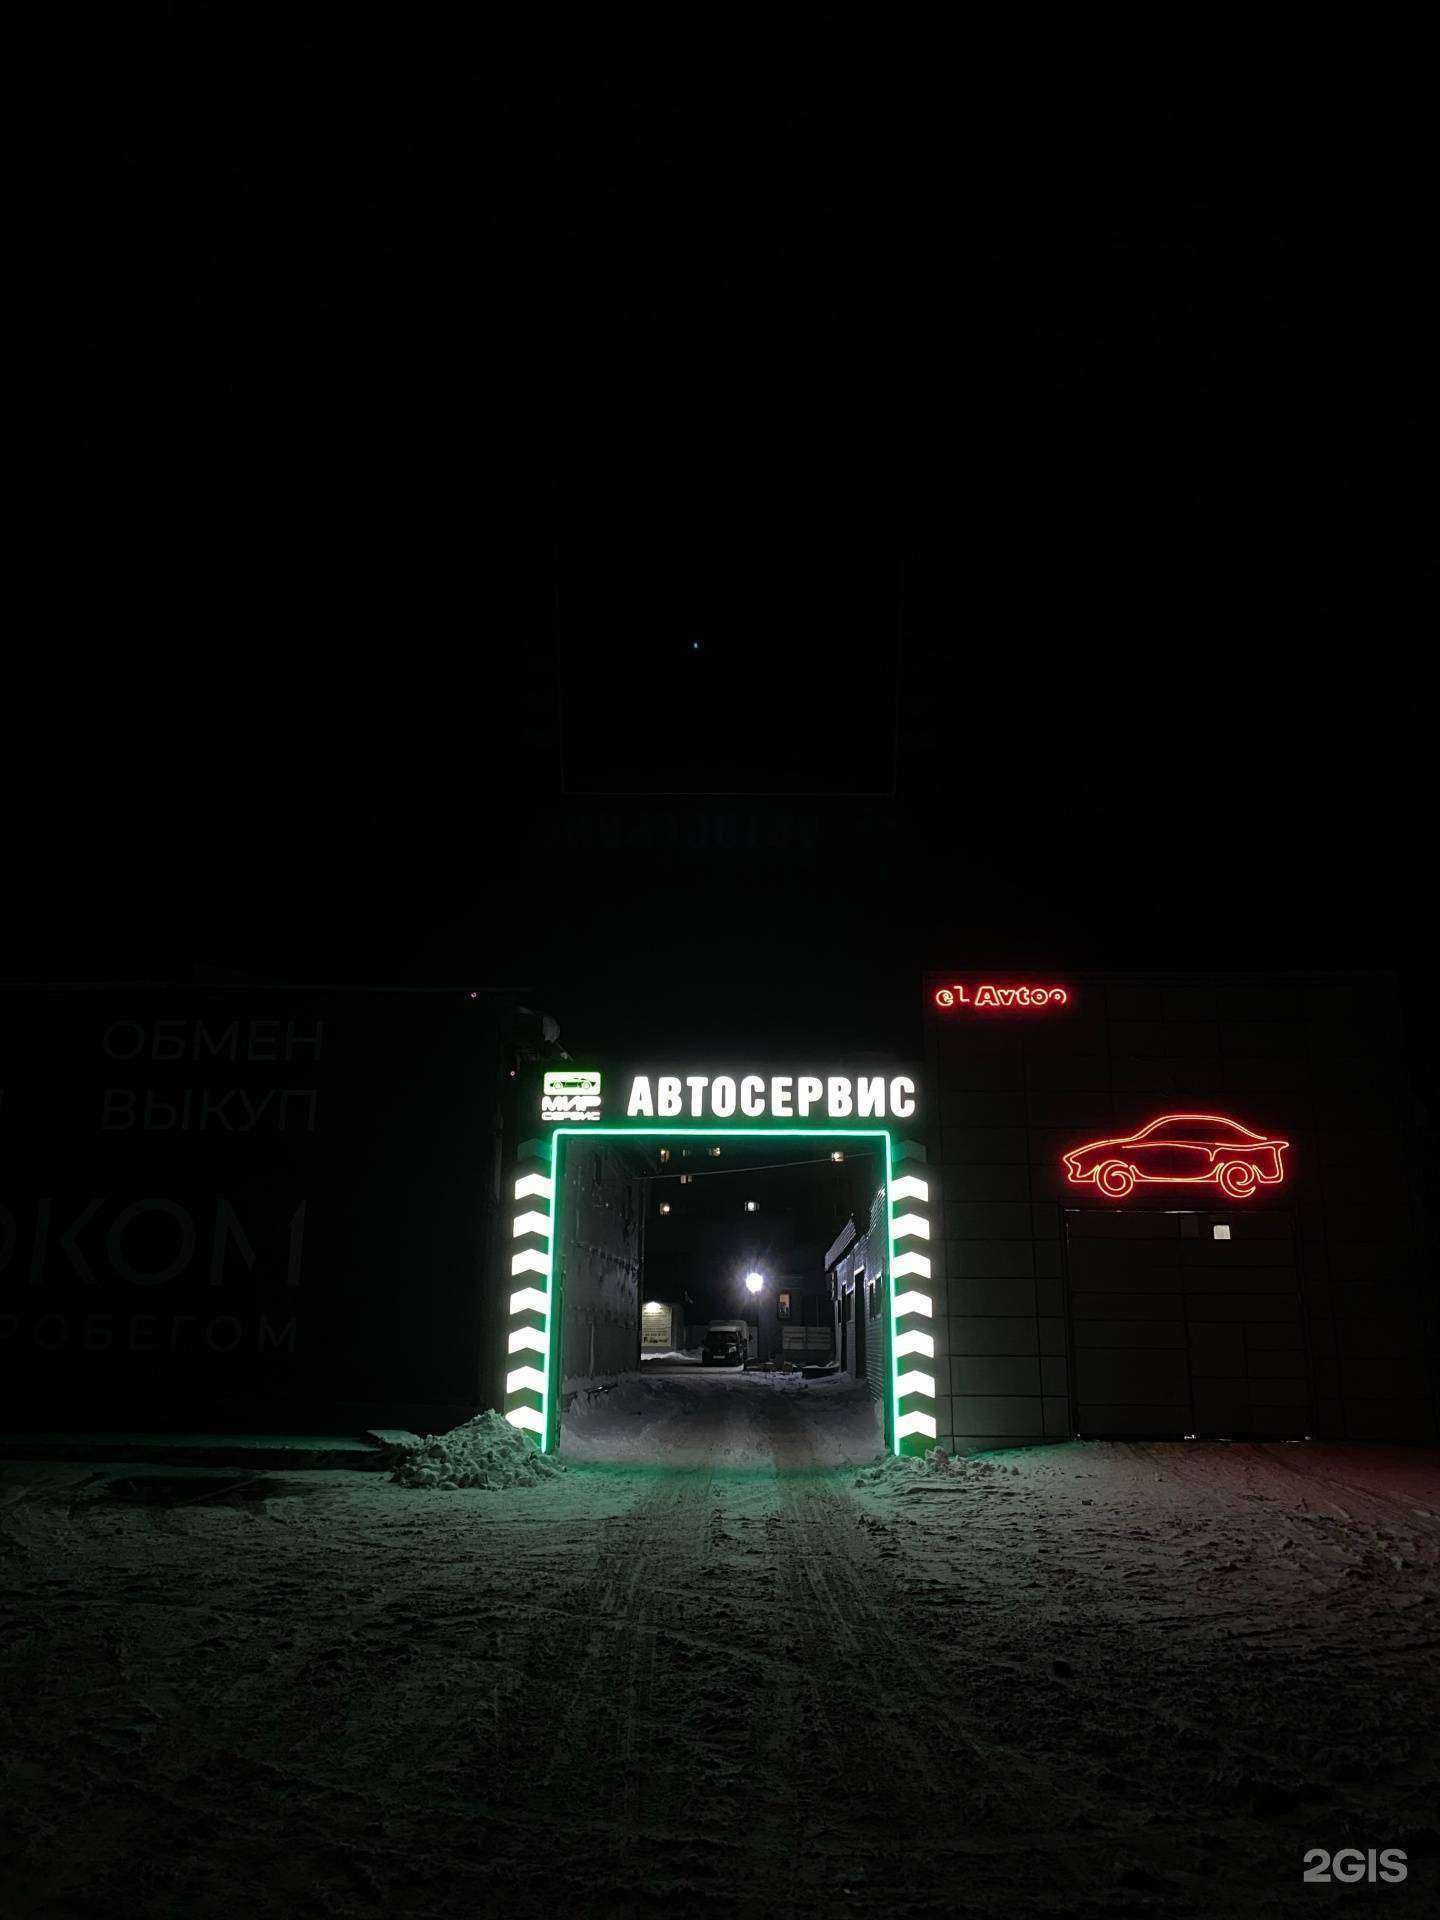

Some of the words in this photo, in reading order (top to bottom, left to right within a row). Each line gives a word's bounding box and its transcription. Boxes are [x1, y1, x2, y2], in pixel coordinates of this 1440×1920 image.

[102, 1019, 324, 1062] ОБМЕН
[100, 1088, 319, 1132] ВЫКУП
[542, 1095, 602, 1112] МИР
[626, 1075, 916, 1119] АВТОСЕРВИС
[0, 1197, 307, 1286] КОМ
